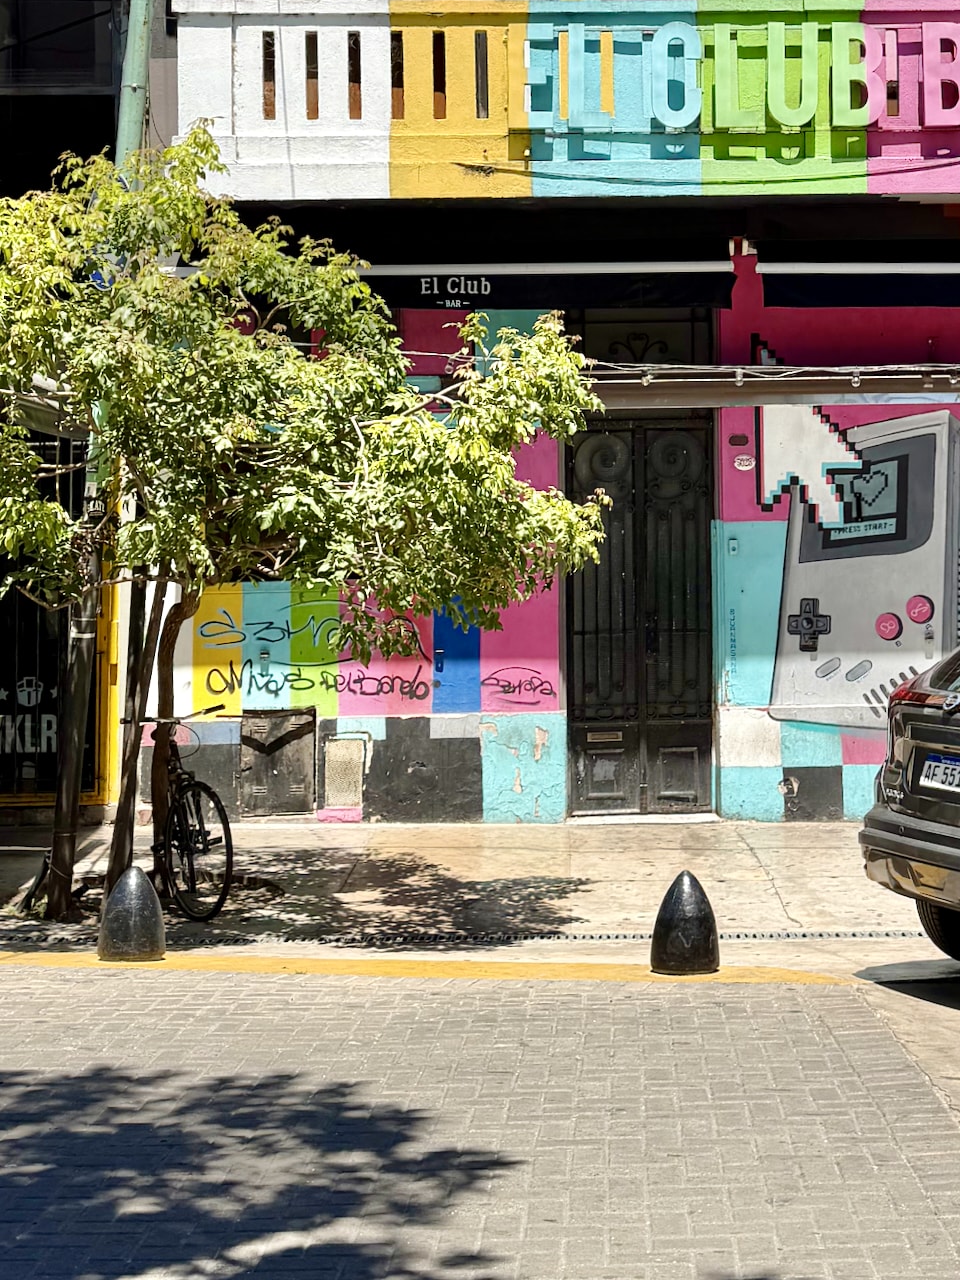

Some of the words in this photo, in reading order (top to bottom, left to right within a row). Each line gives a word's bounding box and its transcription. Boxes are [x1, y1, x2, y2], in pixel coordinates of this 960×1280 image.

[510, 21, 613, 129] EL
[652, 20, 886, 128] CLUB
[420, 277, 440, 295] El
[446, 276, 491, 295] Club
[924, 764, 940, 782] AF
